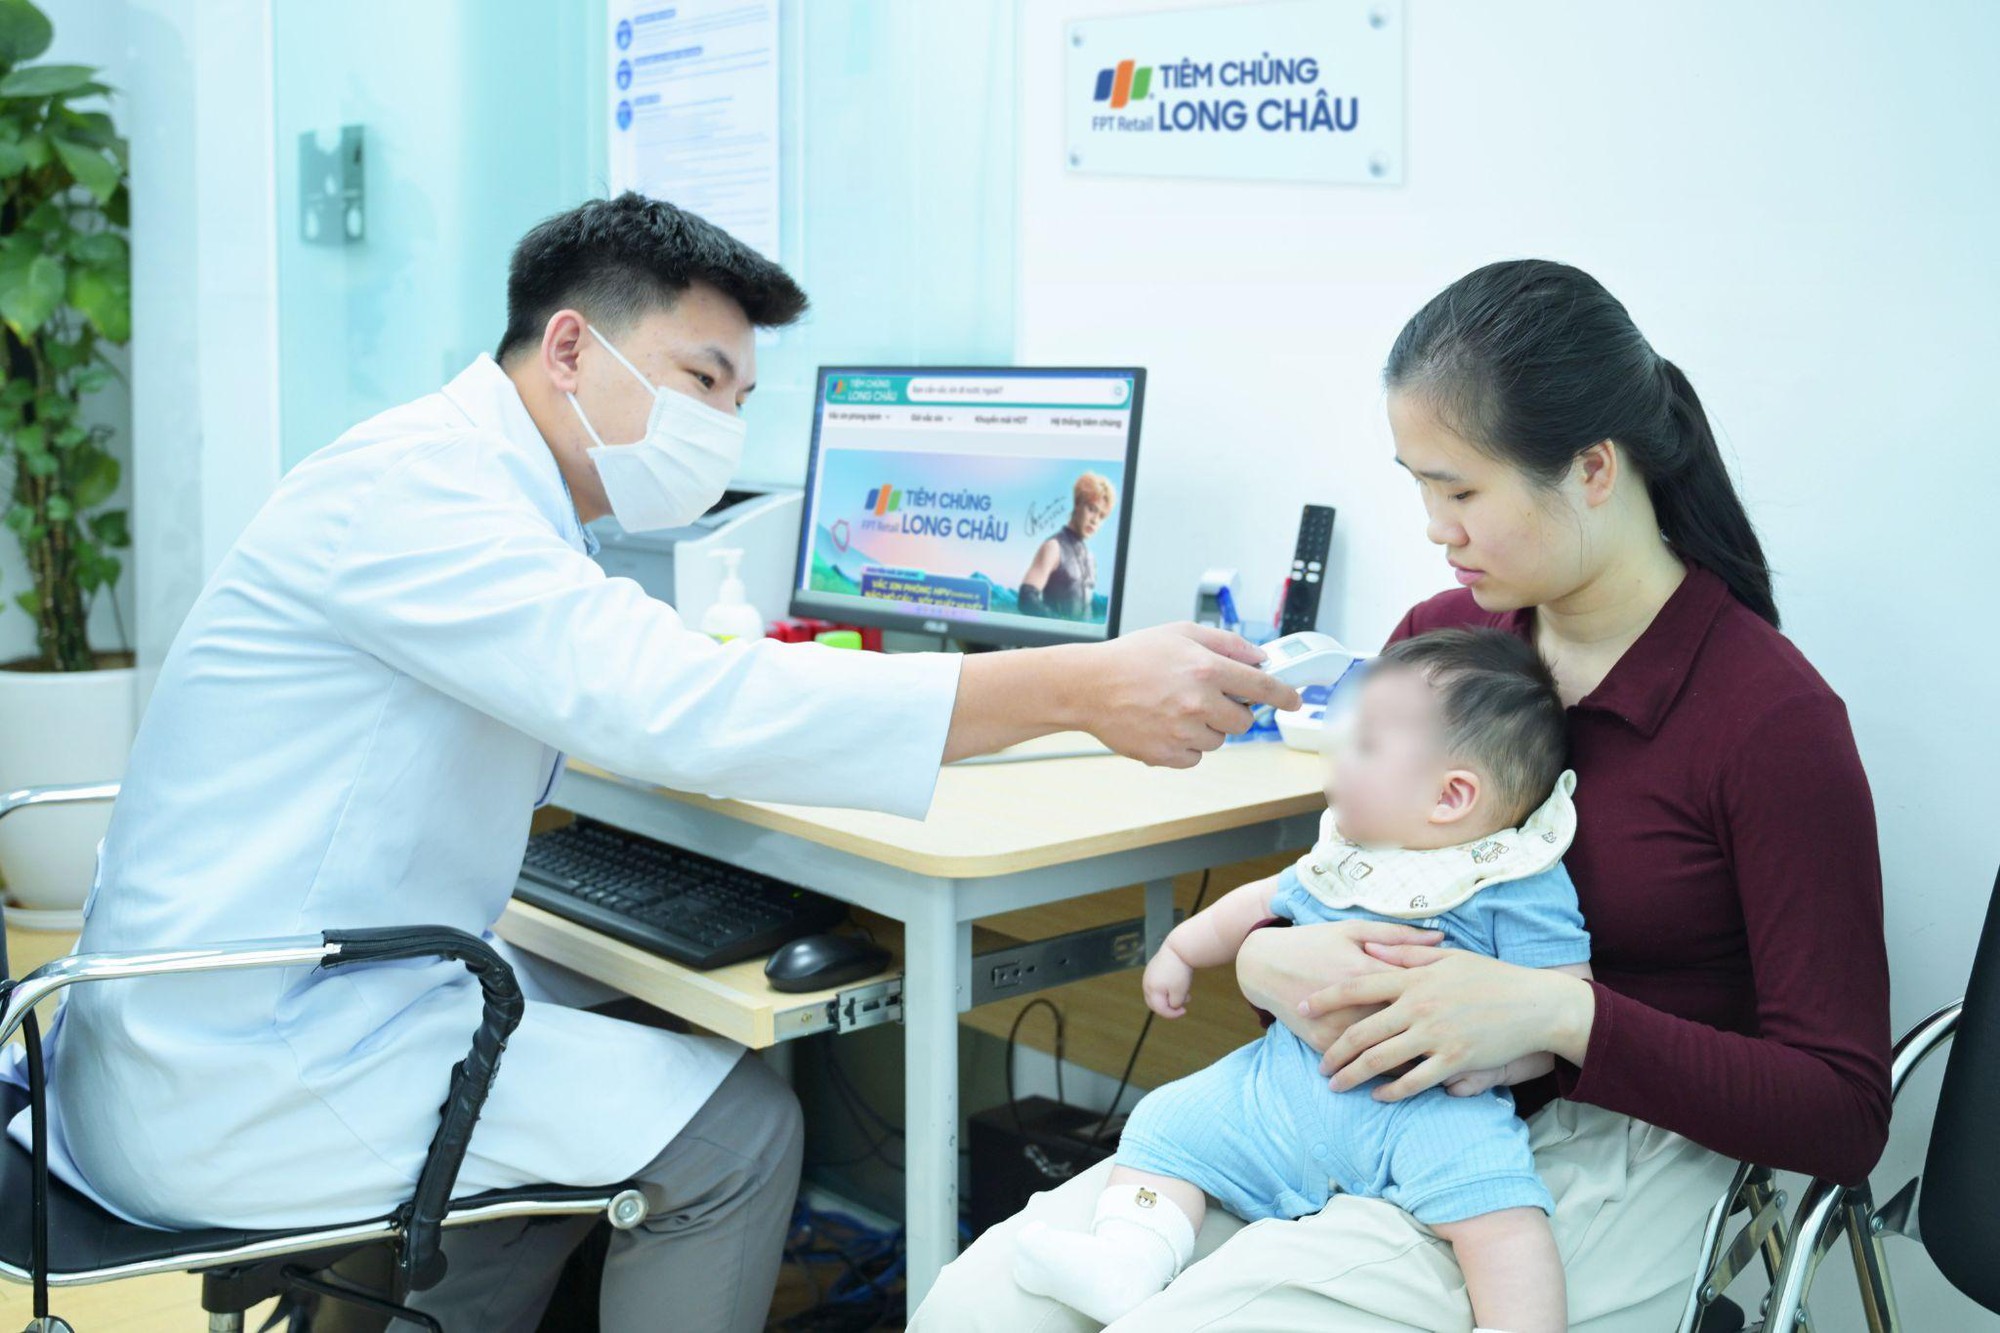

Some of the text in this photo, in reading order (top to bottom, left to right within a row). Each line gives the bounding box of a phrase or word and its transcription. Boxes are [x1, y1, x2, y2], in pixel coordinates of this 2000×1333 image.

[1159, 51, 1319, 89] TIÊM CHỦNG
[1092, 88, 1358, 132] FPT Retail LONG CHÂU
[848, 390, 872, 401] LONG
[906, 487, 992, 512] TIÊM CHỦNG
[901, 513, 953, 537] LONG
[956, 514, 1009, 542] CHÂU
